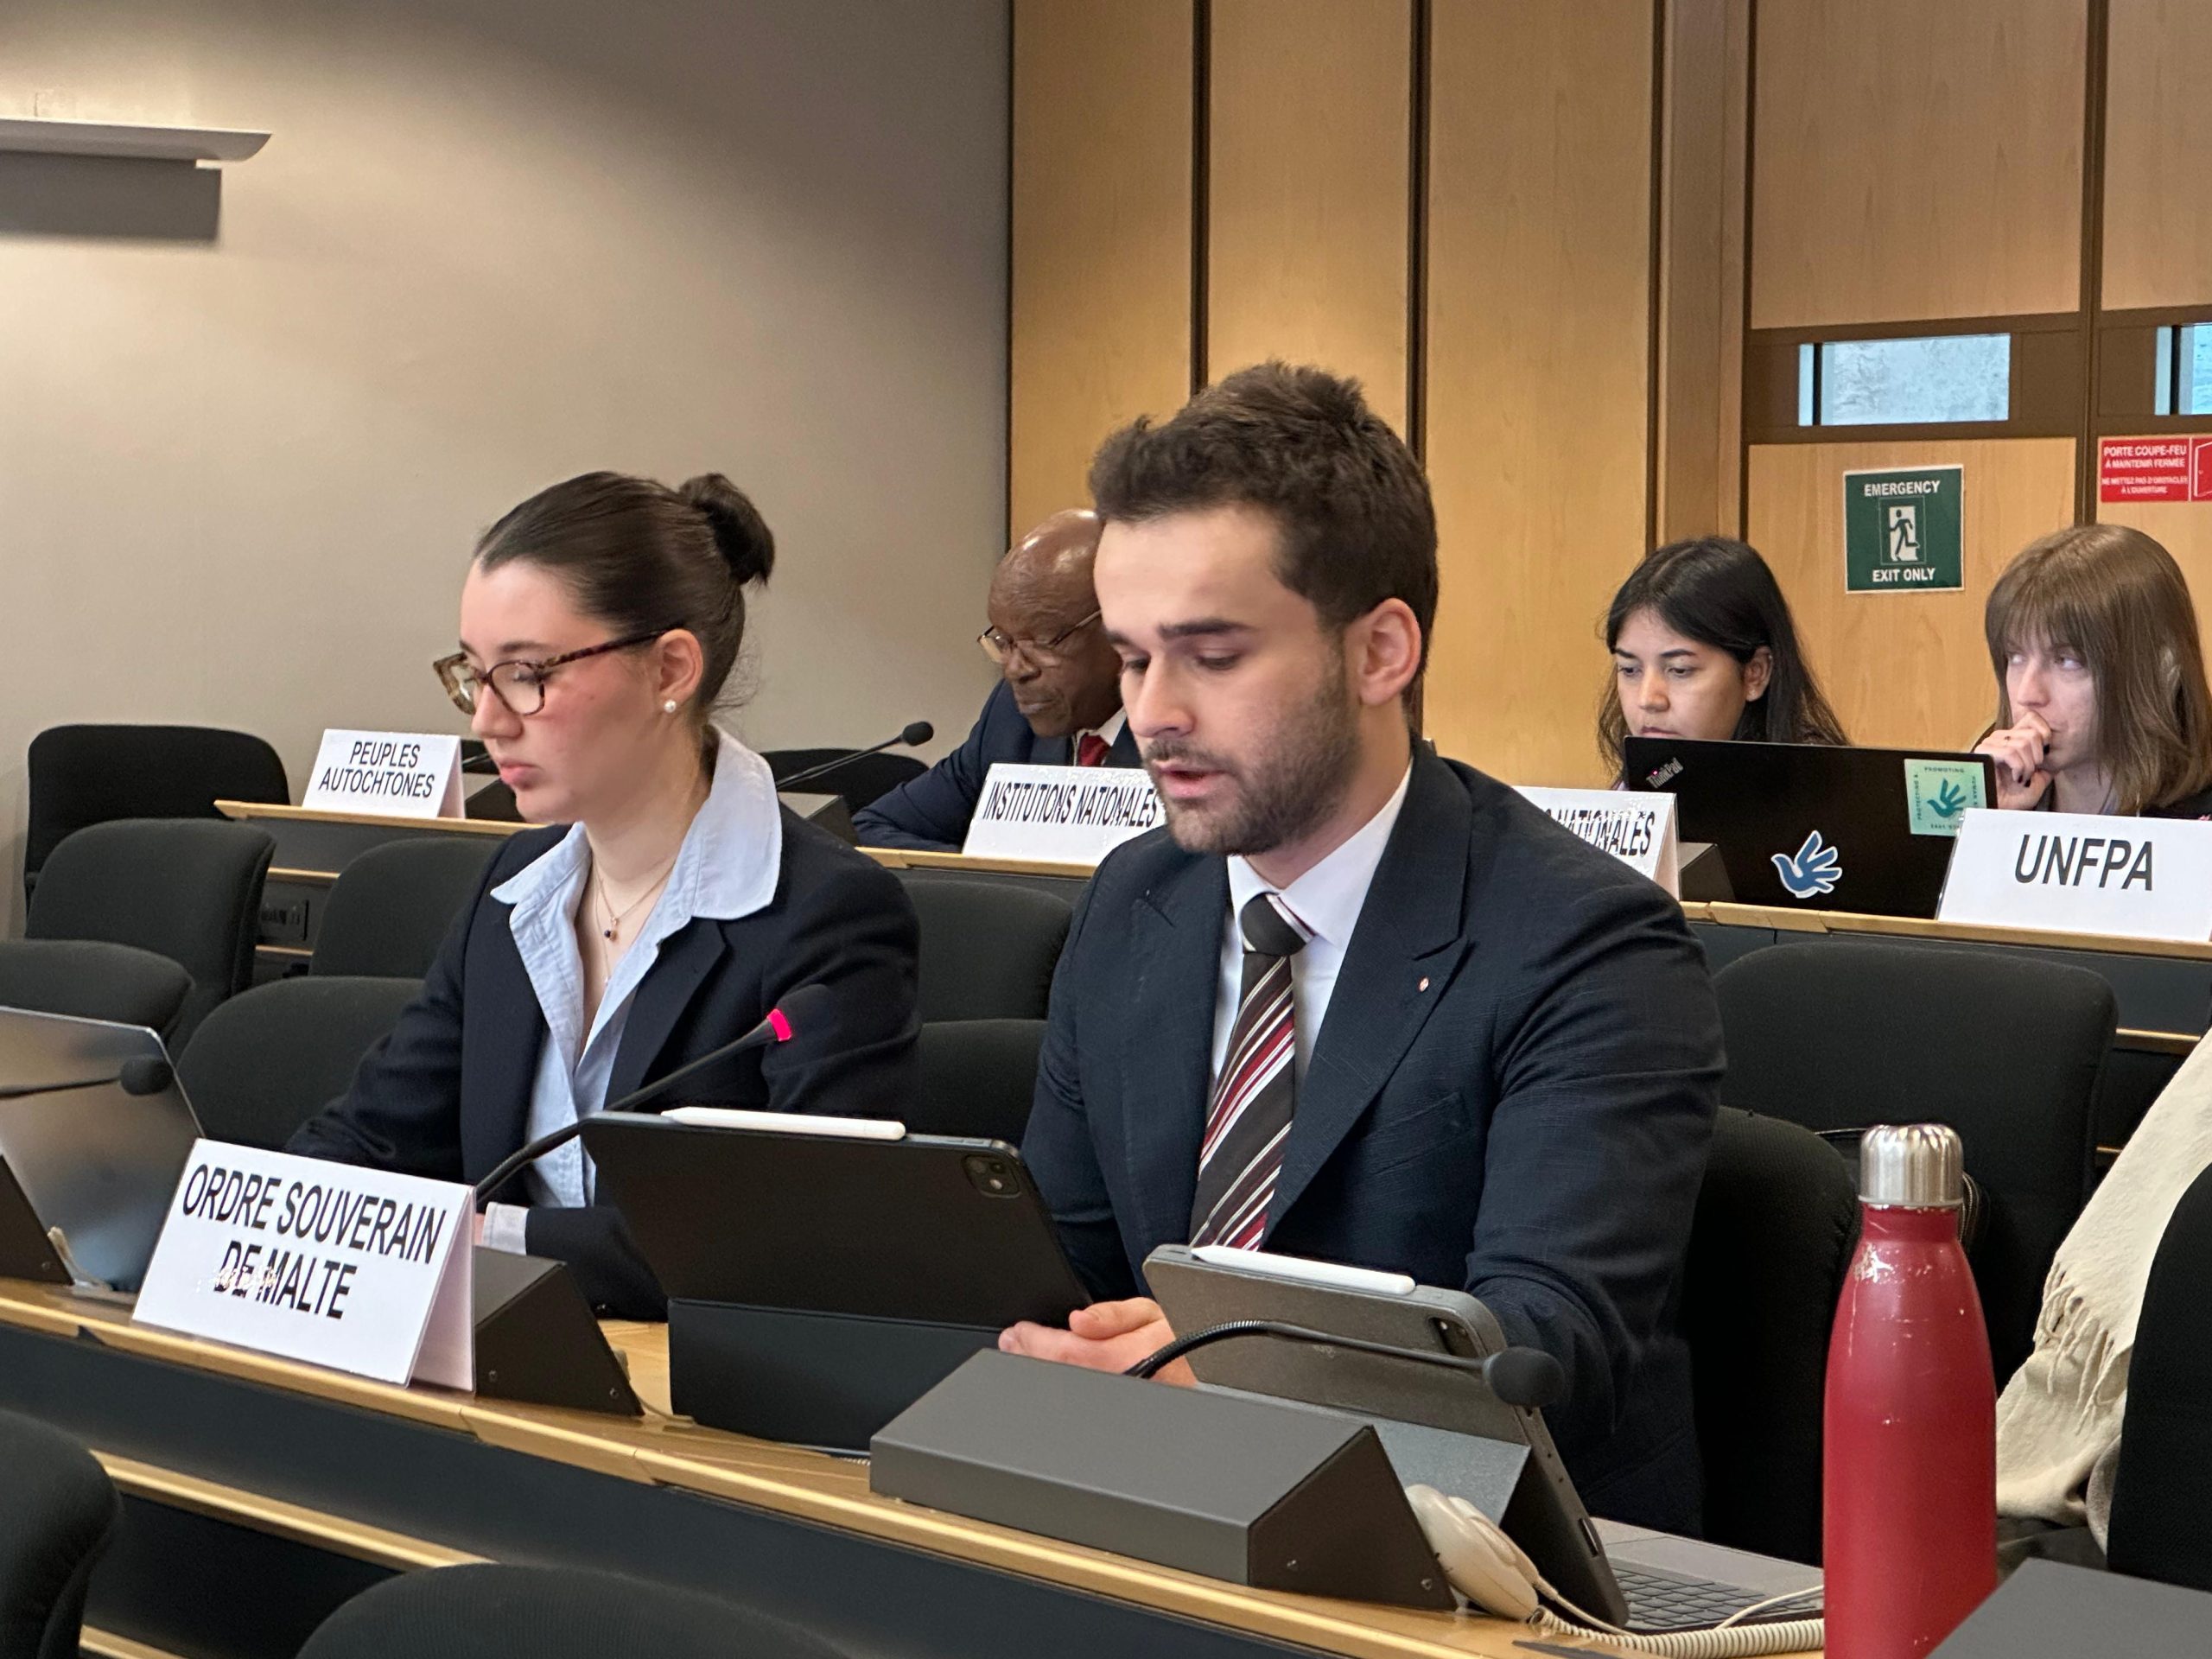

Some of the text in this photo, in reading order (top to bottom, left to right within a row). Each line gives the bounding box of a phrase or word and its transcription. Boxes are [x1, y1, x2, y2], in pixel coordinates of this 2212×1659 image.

[2103, 445, 2187, 457] PORTE COUPE-FEU
[1864, 480, 1941, 496] EMERGENCY
[1872, 568, 1936, 582] EXIT ONLY
[349, 741, 420, 768] PEUPLES
[318, 767, 435, 798] AUTOCHTONES
[1646, 757, 1683, 788] ThinkPad
[982, 781, 1157, 828] INSTITUTIONS NATIONALES
[1558, 809, 1655, 856] TIONALES
[2015, 834, 2152, 891] UNFPA
[182, 1164, 447, 1264] ORDRE SOUVERAIN
[213, 1240, 358, 1319] DE MALTE
